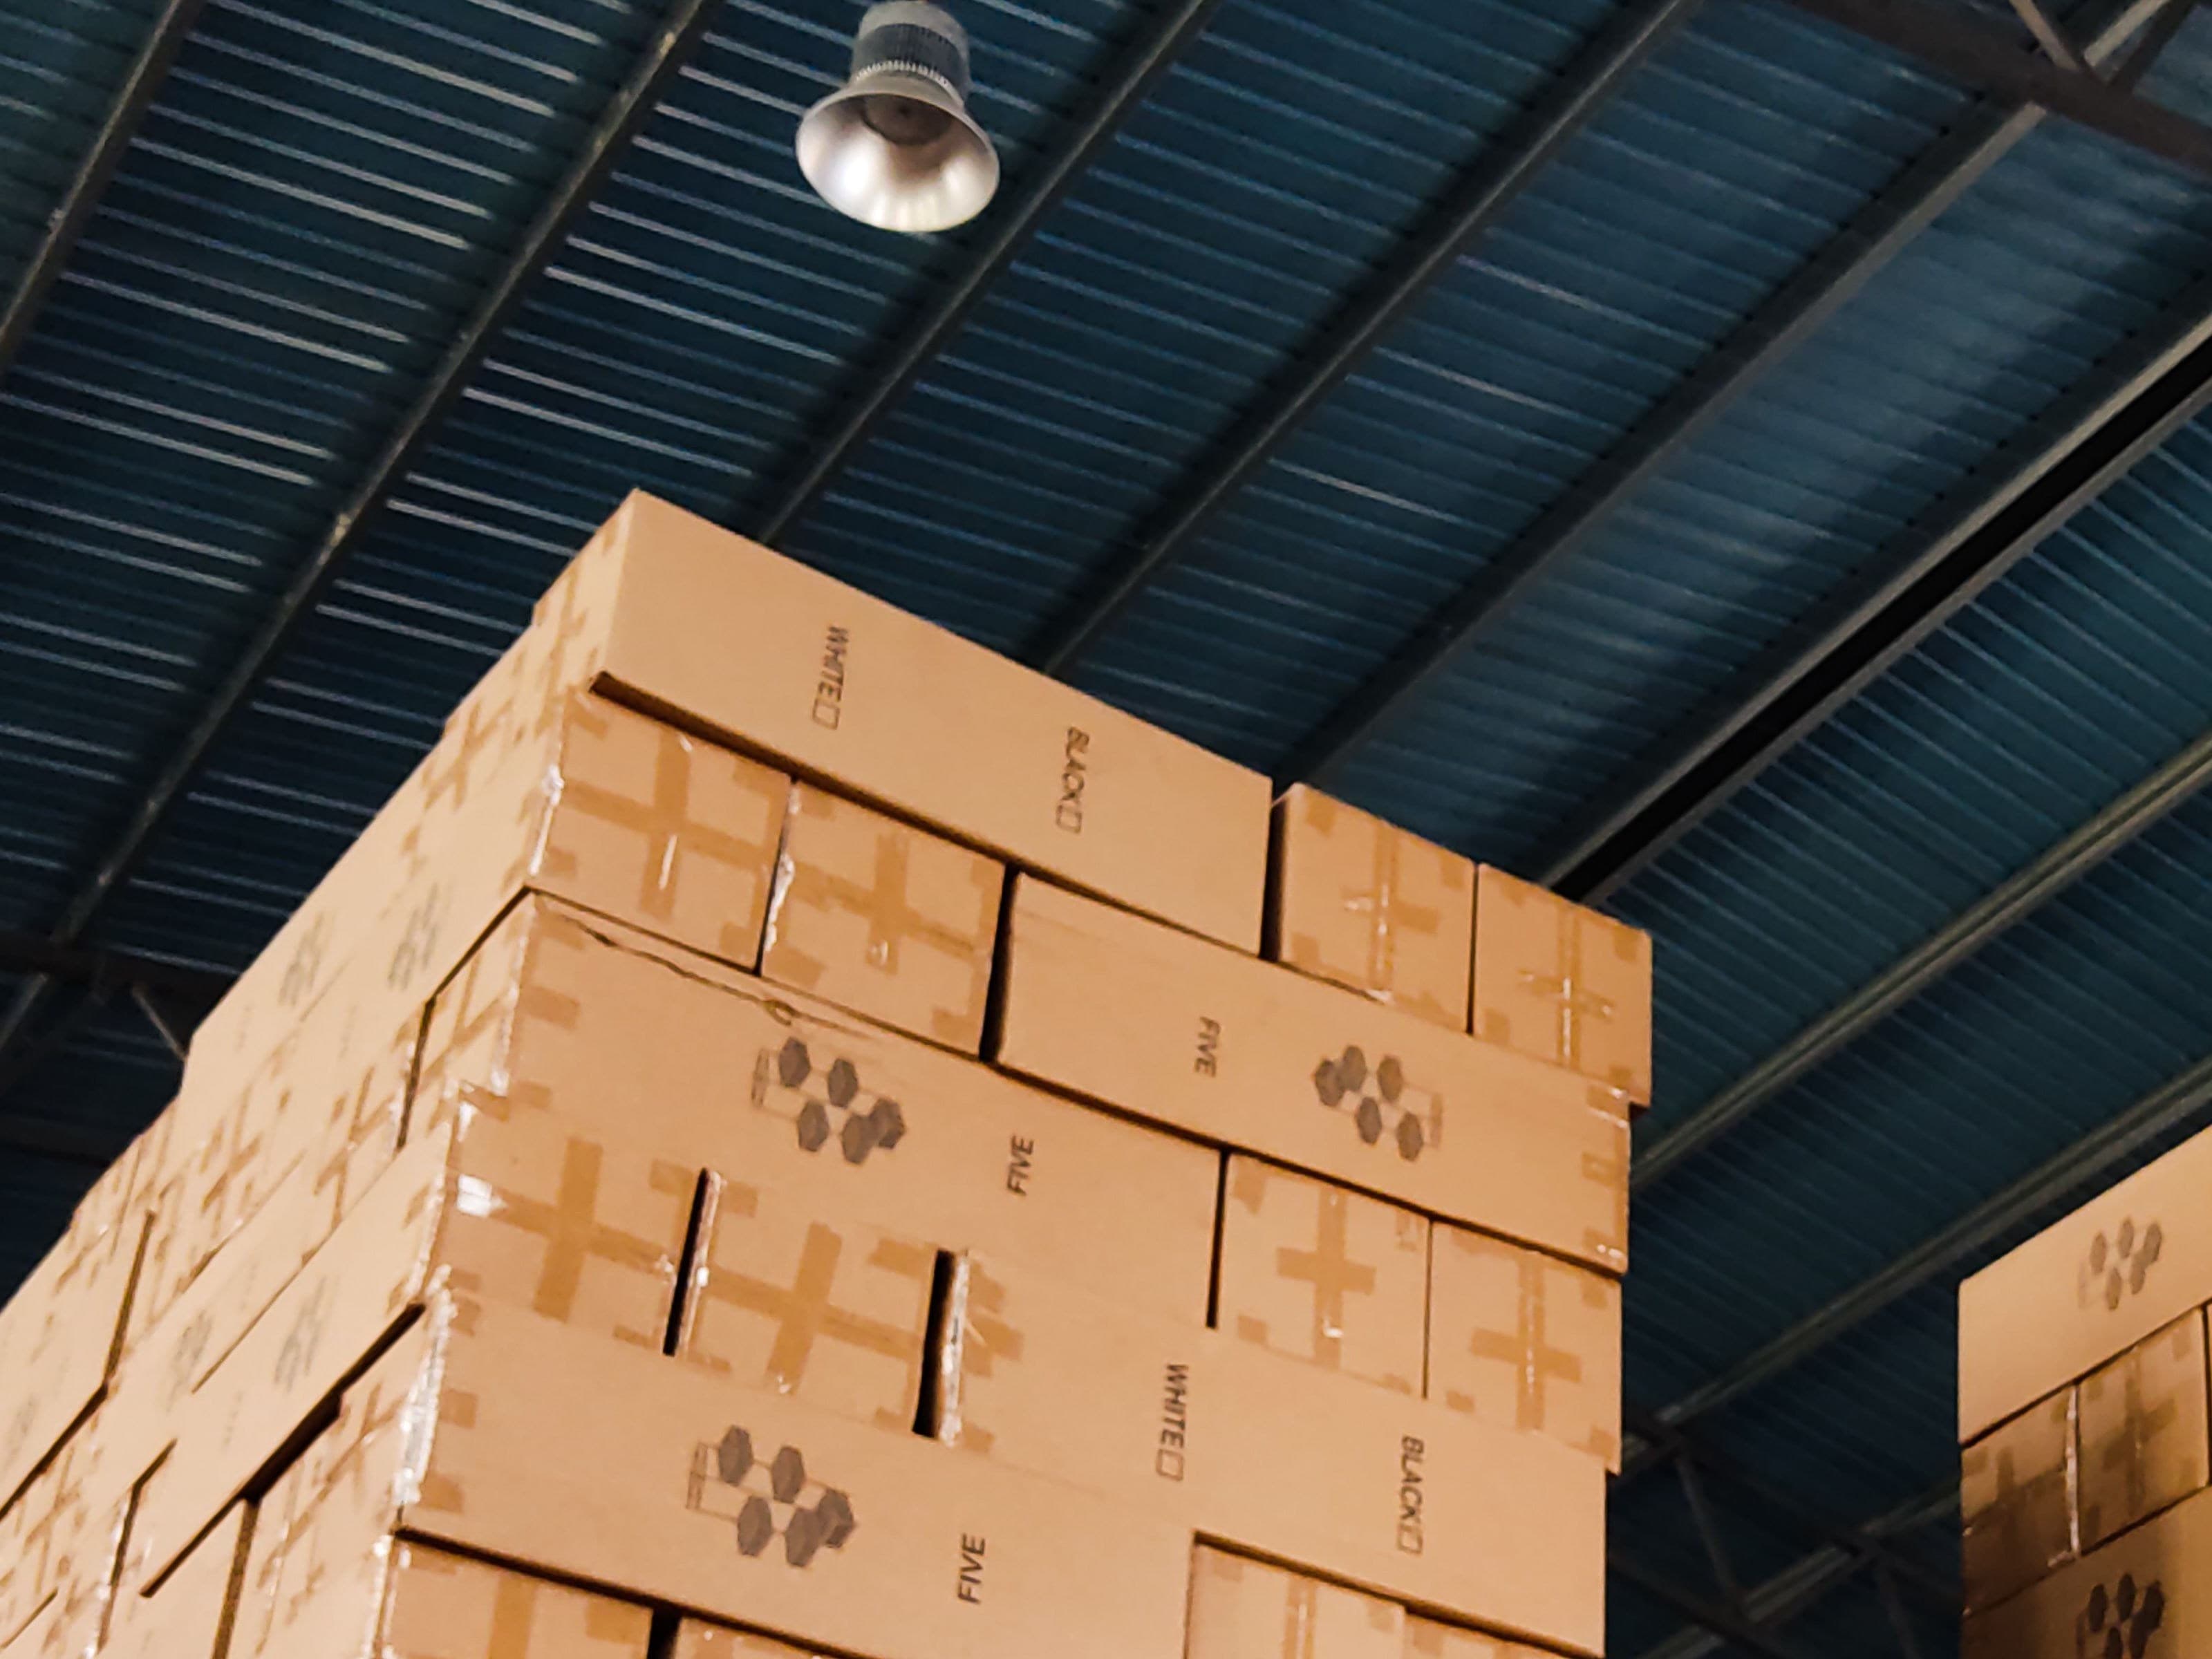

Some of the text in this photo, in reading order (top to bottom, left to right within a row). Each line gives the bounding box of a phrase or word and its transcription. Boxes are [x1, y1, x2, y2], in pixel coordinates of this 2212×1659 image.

[818, 626, 849, 702] WHITE
[1061, 727, 1089, 803] BLACK
[1194, 1015, 1221, 1078] FIVE
[1006, 1134, 1034, 1197] FIVE
[1161, 1364, 1189, 1448] WHITE
[1400, 1434, 1424, 1524] BLACK
[957, 1533, 985, 1604] FIVE
